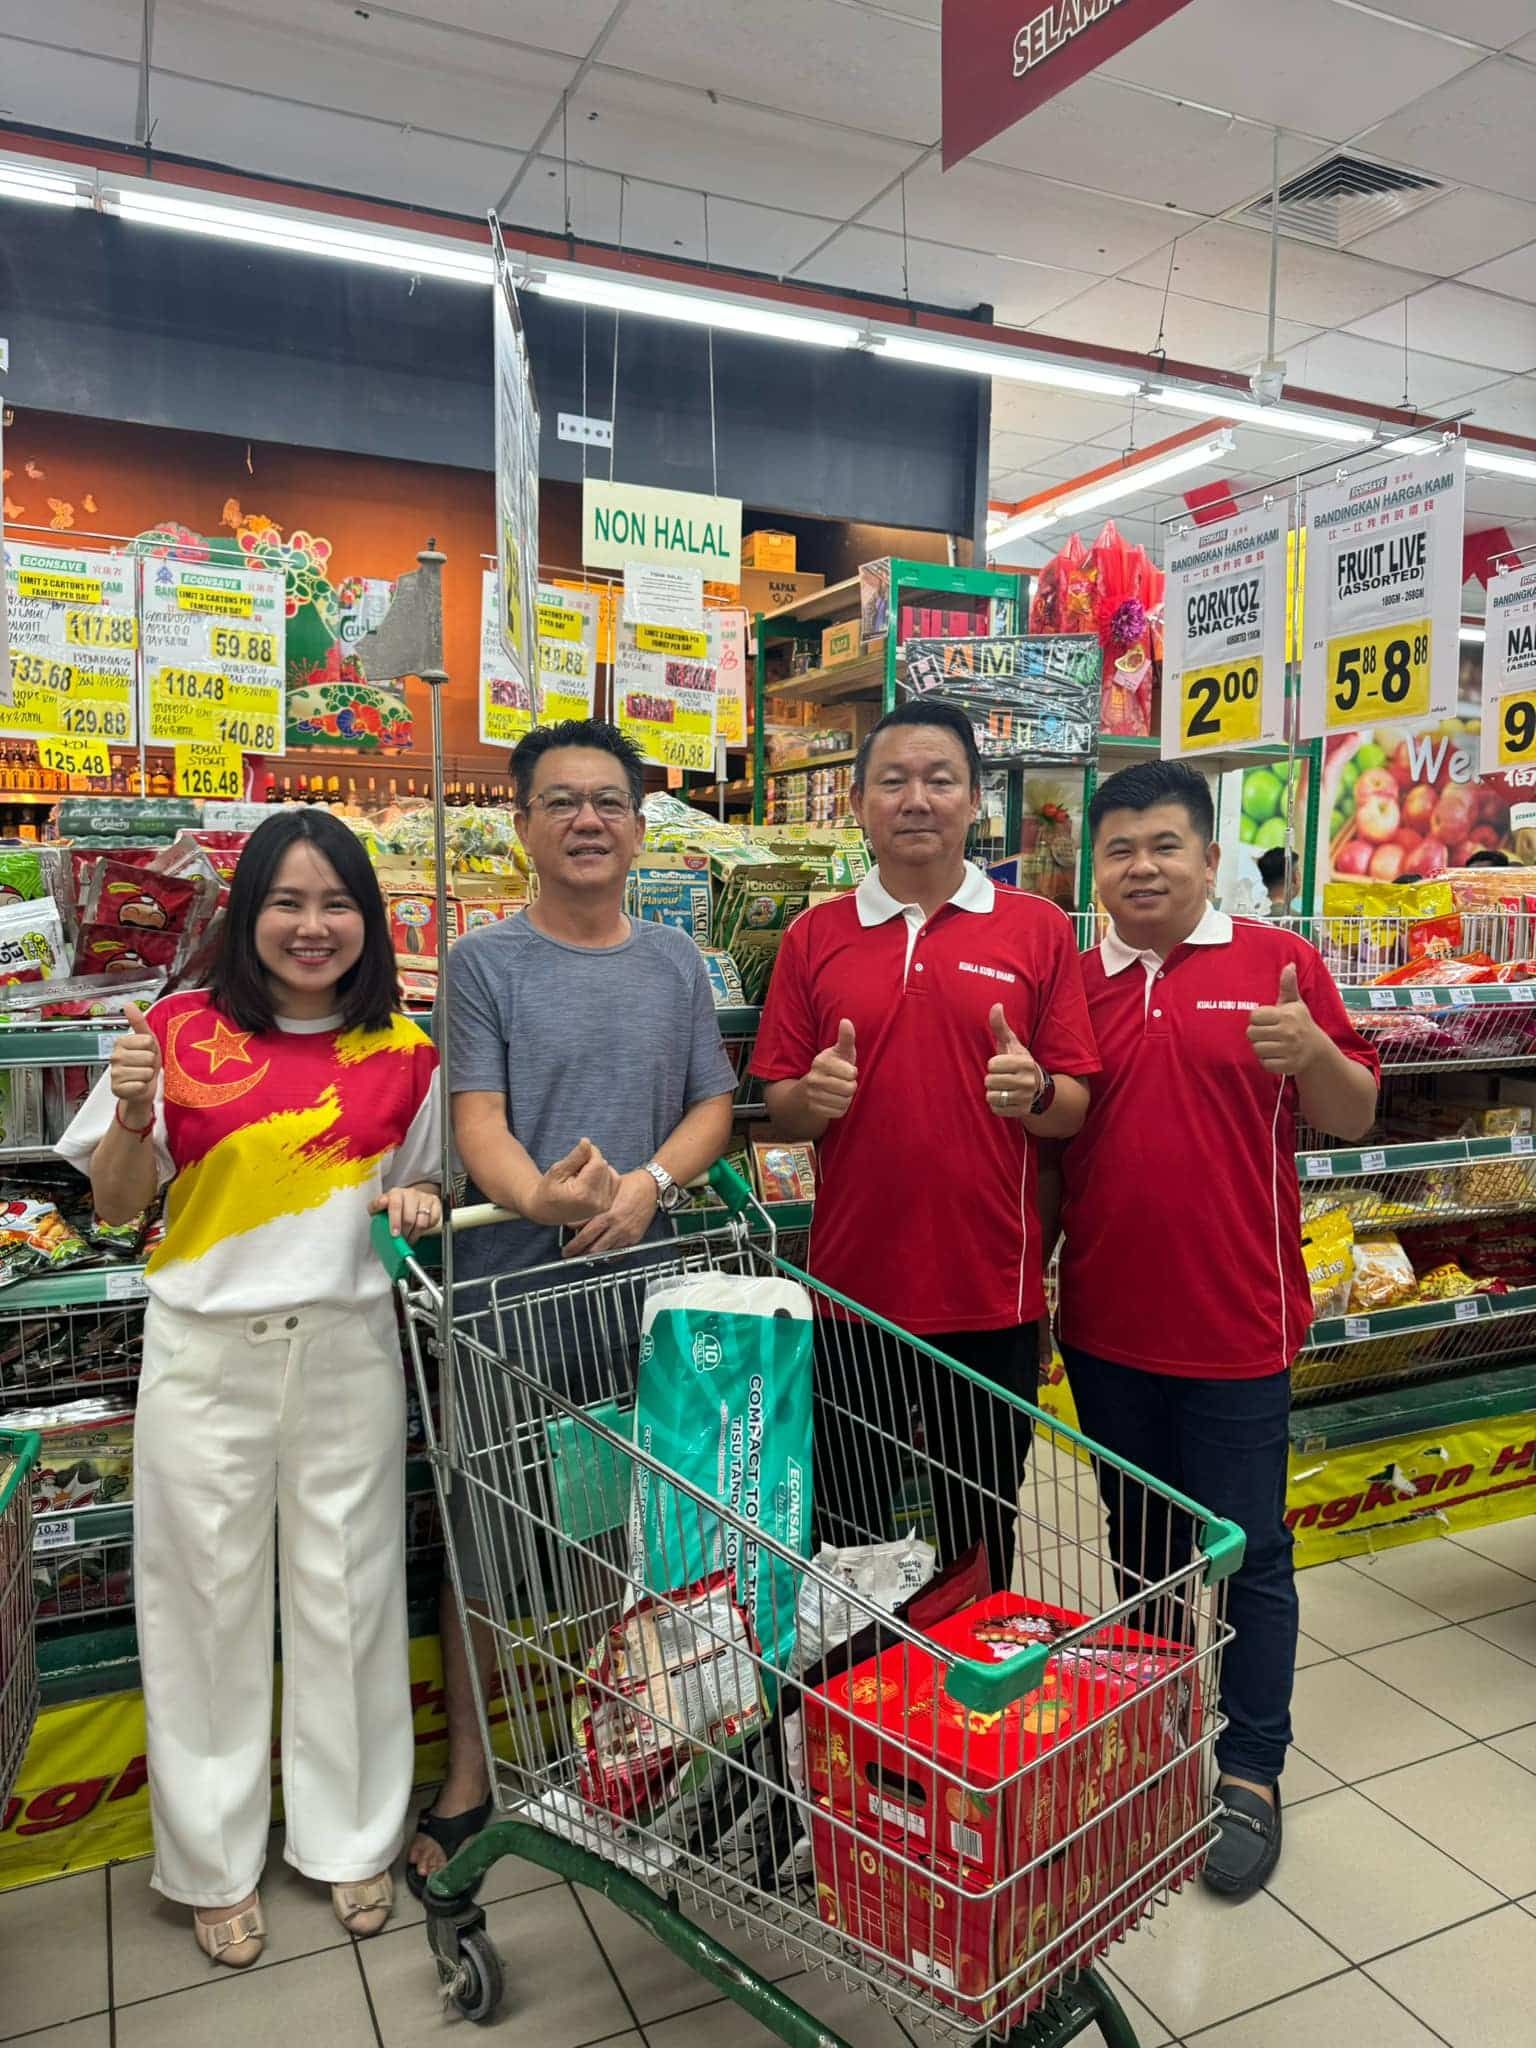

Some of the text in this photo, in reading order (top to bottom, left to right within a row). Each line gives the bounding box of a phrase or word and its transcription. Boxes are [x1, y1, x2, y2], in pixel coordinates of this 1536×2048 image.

[1314, 496, 1381, 528] BANDINGKAN
[1383, 484, 1422, 507] HARGA
[1424, 472, 1454, 494] KAMI
[595, 507, 730, 557] NON HALAL
[21, 555, 86, 573] ECONSAVE
[1171, 547, 1223, 572] BANDINGKAN
[1225, 539, 1255, 555] HARGA
[1256, 528, 1279, 542] KAMI
[1338, 531, 1426, 586] FRUIT LIVE
[20, 576, 41, 586] LIMIT
[49, 579, 85, 591] CARTONS
[86, 581, 101, 592] PER
[32, 588, 90, 601] FAMILY PER DAY
[769, 582, 797, 592] KAPAK
[1338, 567, 1425, 600] (ASSORTED)
[205, 594, 238, 604] CARTONS
[1187, 579, 1260, 627] CORNTOZ
[1187, 611, 1258, 639] SNACKS
[216, 632, 272, 663] 59.88
[1508, 624, 1536, 657] NA
[167, 671, 225, 701] 118.48
[64, 708, 127, 736] 129.88
[220, 718, 275, 750] 140.88
[45, 748, 105, 774] 125.48
[182, 767, 239, 795] 126.48
[705, 1343, 718, 1363] 10
[731, 1417, 743, 1455] TISU
[38, 1521, 68, 1536] 10.28
